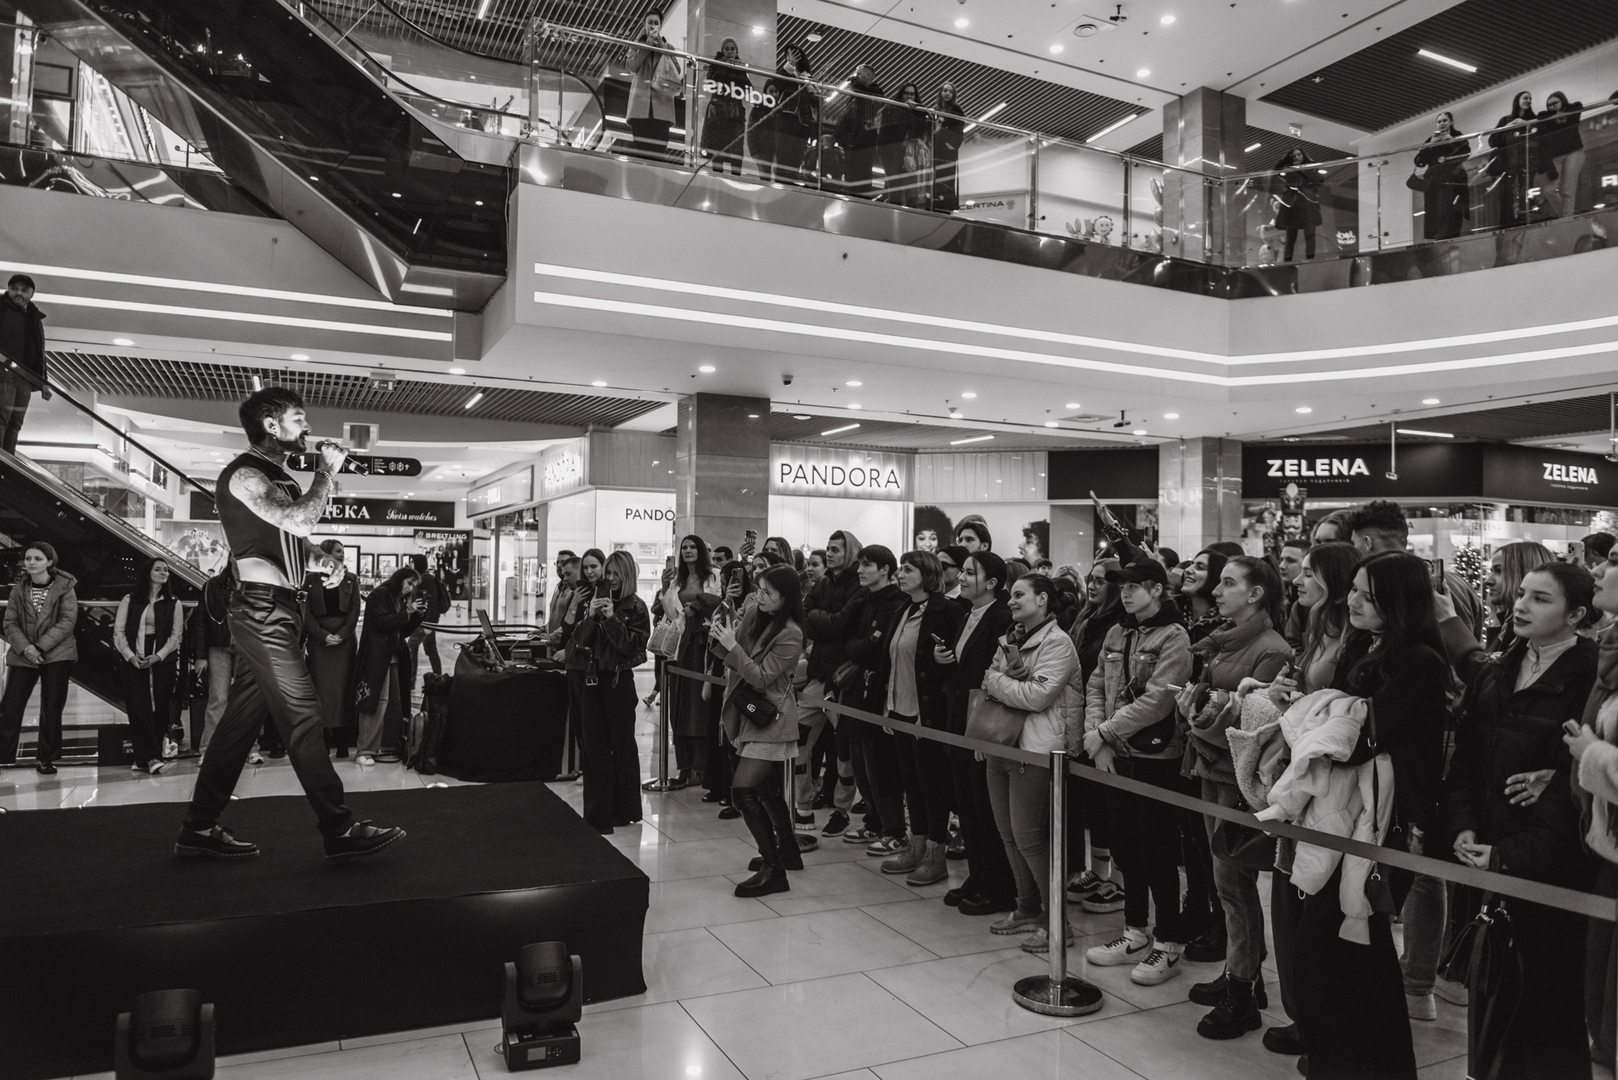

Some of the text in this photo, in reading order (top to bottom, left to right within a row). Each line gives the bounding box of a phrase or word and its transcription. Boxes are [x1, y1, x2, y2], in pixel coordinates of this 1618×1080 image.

[780, 463, 900, 489] PANDORA
[1266, 458, 1370, 477] ZELENA
[1543, 463, 1599, 484] ZELENA
[386, 508, 437, 522] Swiss watches
[425, 532, 467, 540] BREITLING
